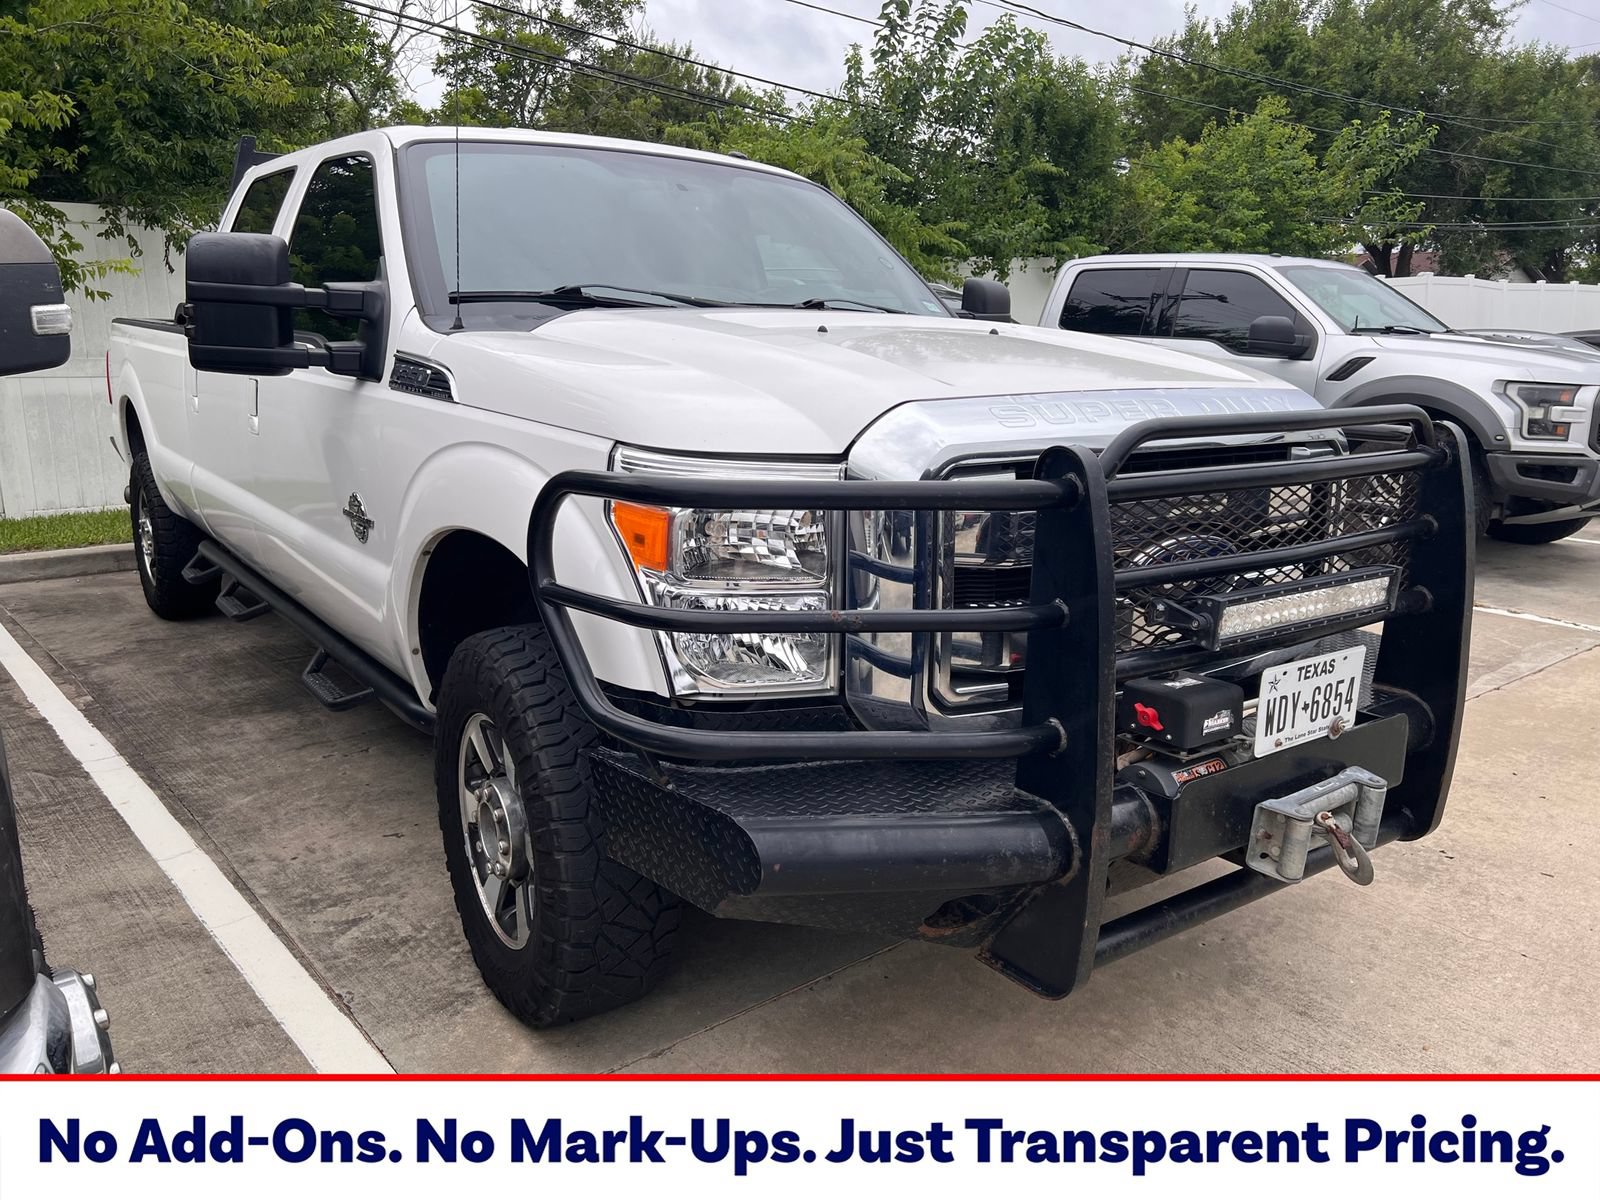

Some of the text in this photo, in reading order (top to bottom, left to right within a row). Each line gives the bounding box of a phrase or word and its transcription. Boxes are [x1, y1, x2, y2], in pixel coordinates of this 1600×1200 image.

[988, 398, 1184, 429] SUPER
[1297, 659, 1336, 682] TEXAS
[1294, 732, 1306, 740] Lone
